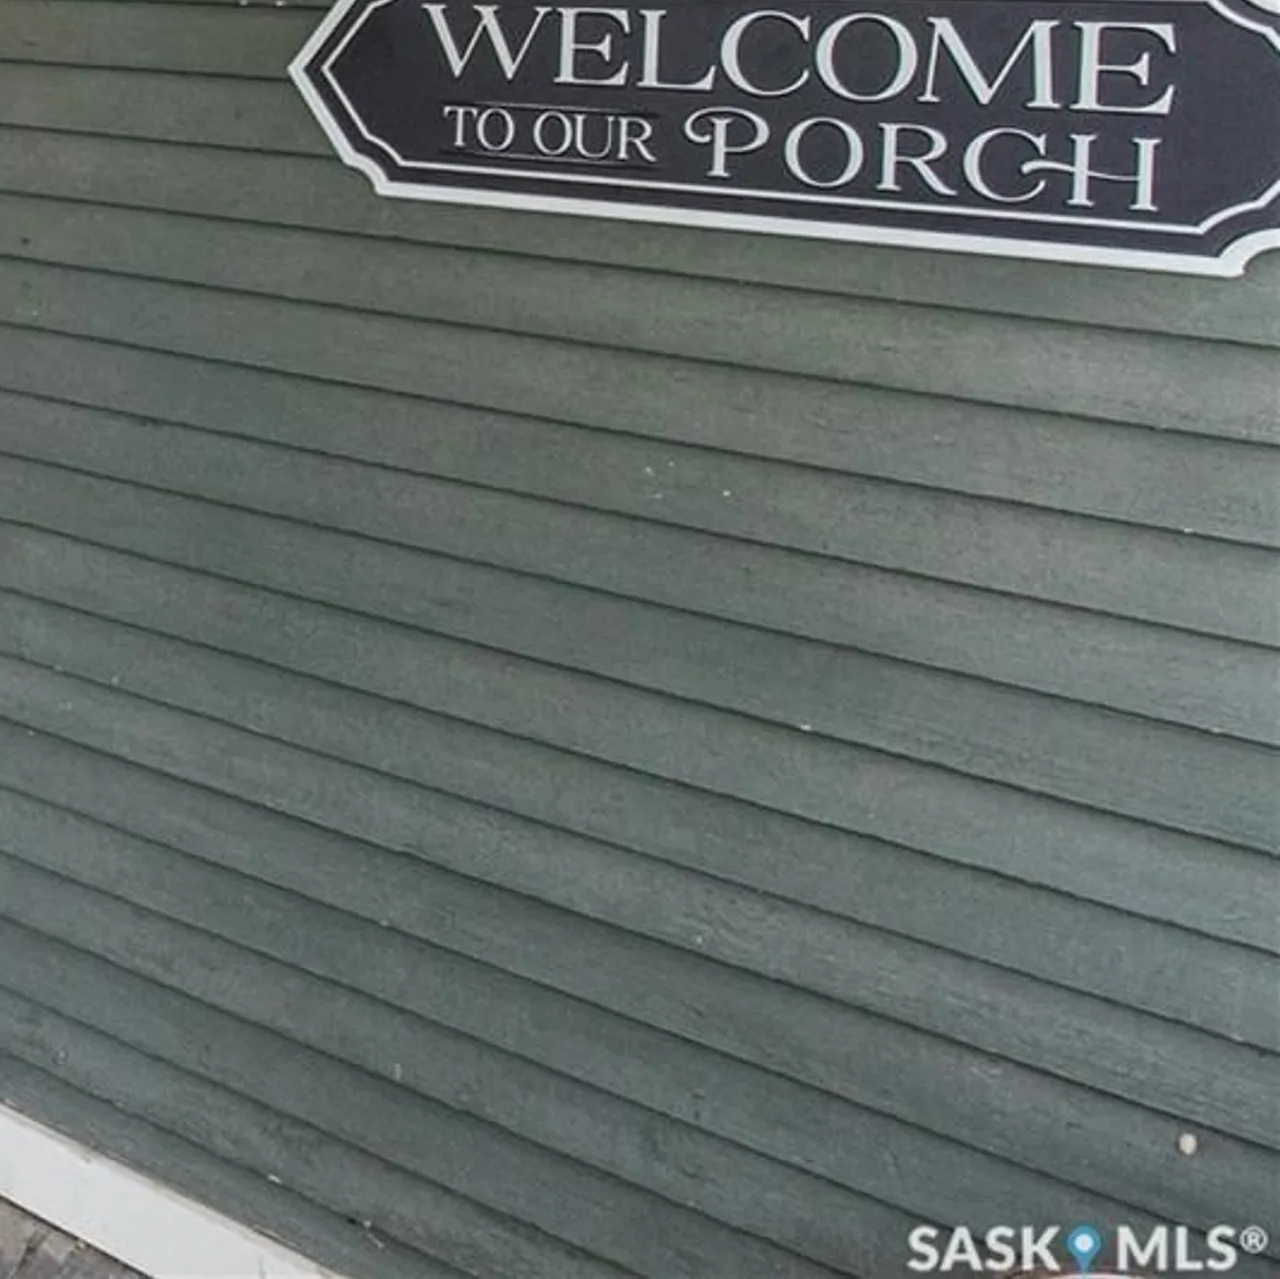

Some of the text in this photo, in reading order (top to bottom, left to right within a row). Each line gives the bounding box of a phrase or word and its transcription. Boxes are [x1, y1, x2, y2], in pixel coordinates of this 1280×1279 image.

[421, 1, 1179, 116] WELCOME
[442, 103, 1164, 212] TO OUR PORCH
